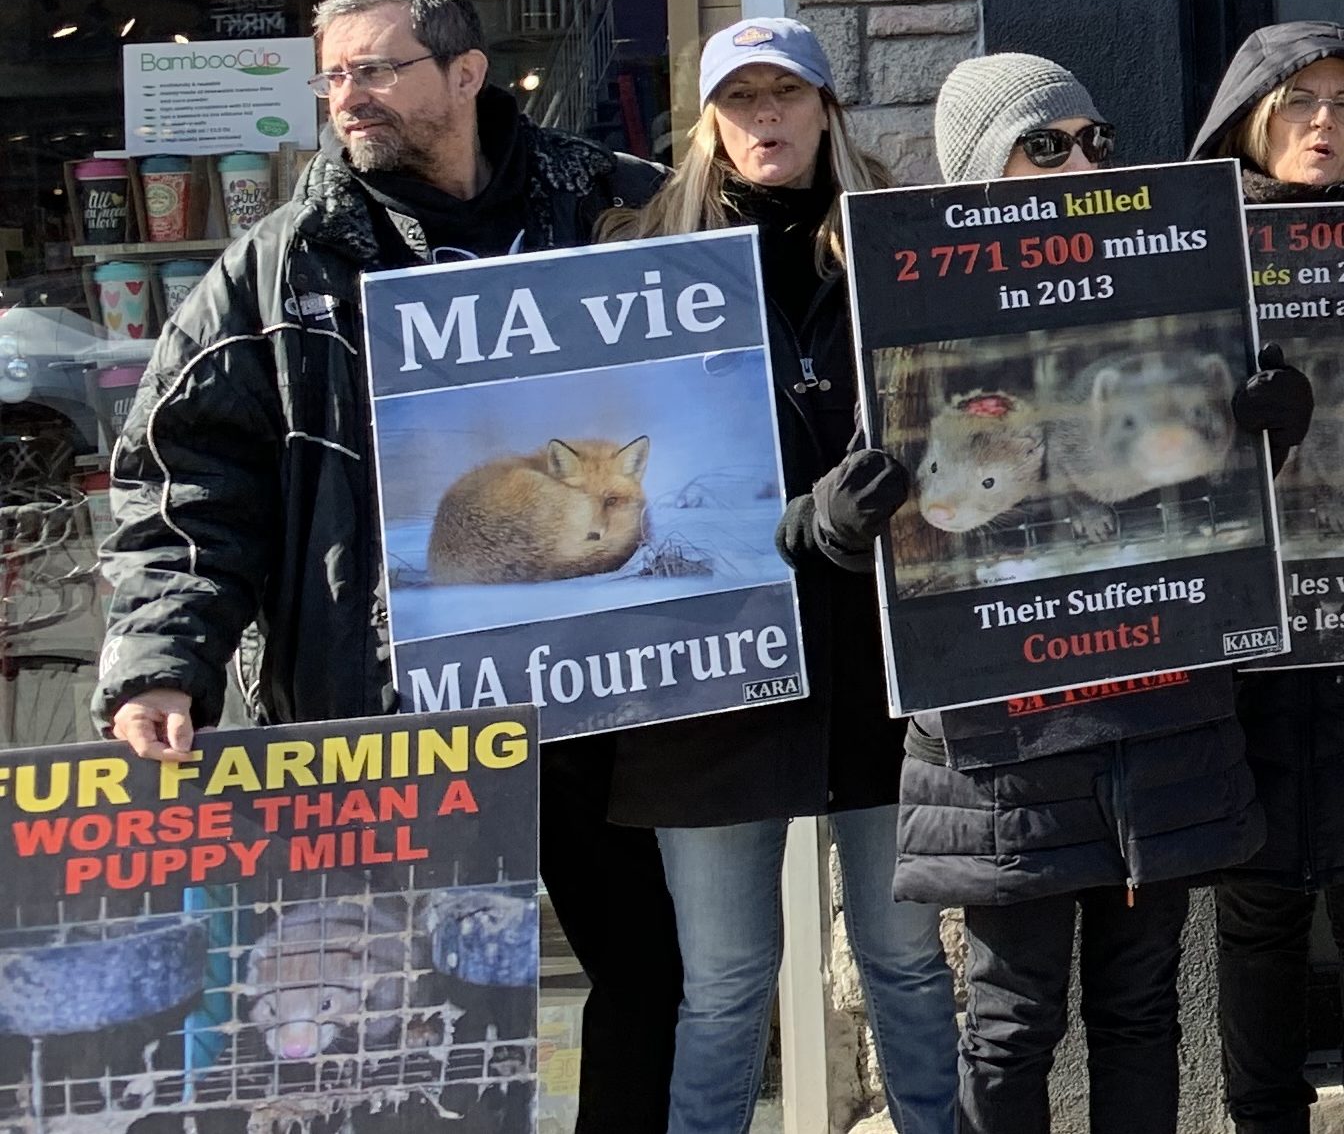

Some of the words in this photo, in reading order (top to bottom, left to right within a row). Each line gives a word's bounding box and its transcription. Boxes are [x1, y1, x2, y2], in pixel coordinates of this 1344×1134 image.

[945, 197, 1058, 229] Canada
[1064, 186, 1152, 218] killed
[895, 251, 919, 281] 2
[931, 242, 1008, 277] 771
[1020, 233, 1094, 268] 500
[1103, 226, 1208, 259] minks
[1297, 267, 1330, 284] en
[1000, 285, 1030, 309] in
[1037, 274, 1114, 306] 2013
[396, 288, 559, 371] MA
[581, 271, 726, 345] vie
[974, 599, 1061, 629] Their
[1068, 575, 1205, 615] Suffering
[1290, 573, 1329, 596] les
[1023, 614, 1162, 663] Counts!
[1226, 631, 1276, 651] KARA
[409, 657, 508, 714] MA
[526, 624, 788, 706] fourrure
[746, 679, 798, 700] KARA
[159, 722, 529, 800] FARMING
[12, 802, 233, 856] WORSE
[255, 785, 418, 832] THAN
[437, 780, 478, 815] A
[65, 841, 271, 895] PUPPY
[290, 826, 428, 872] MILL
